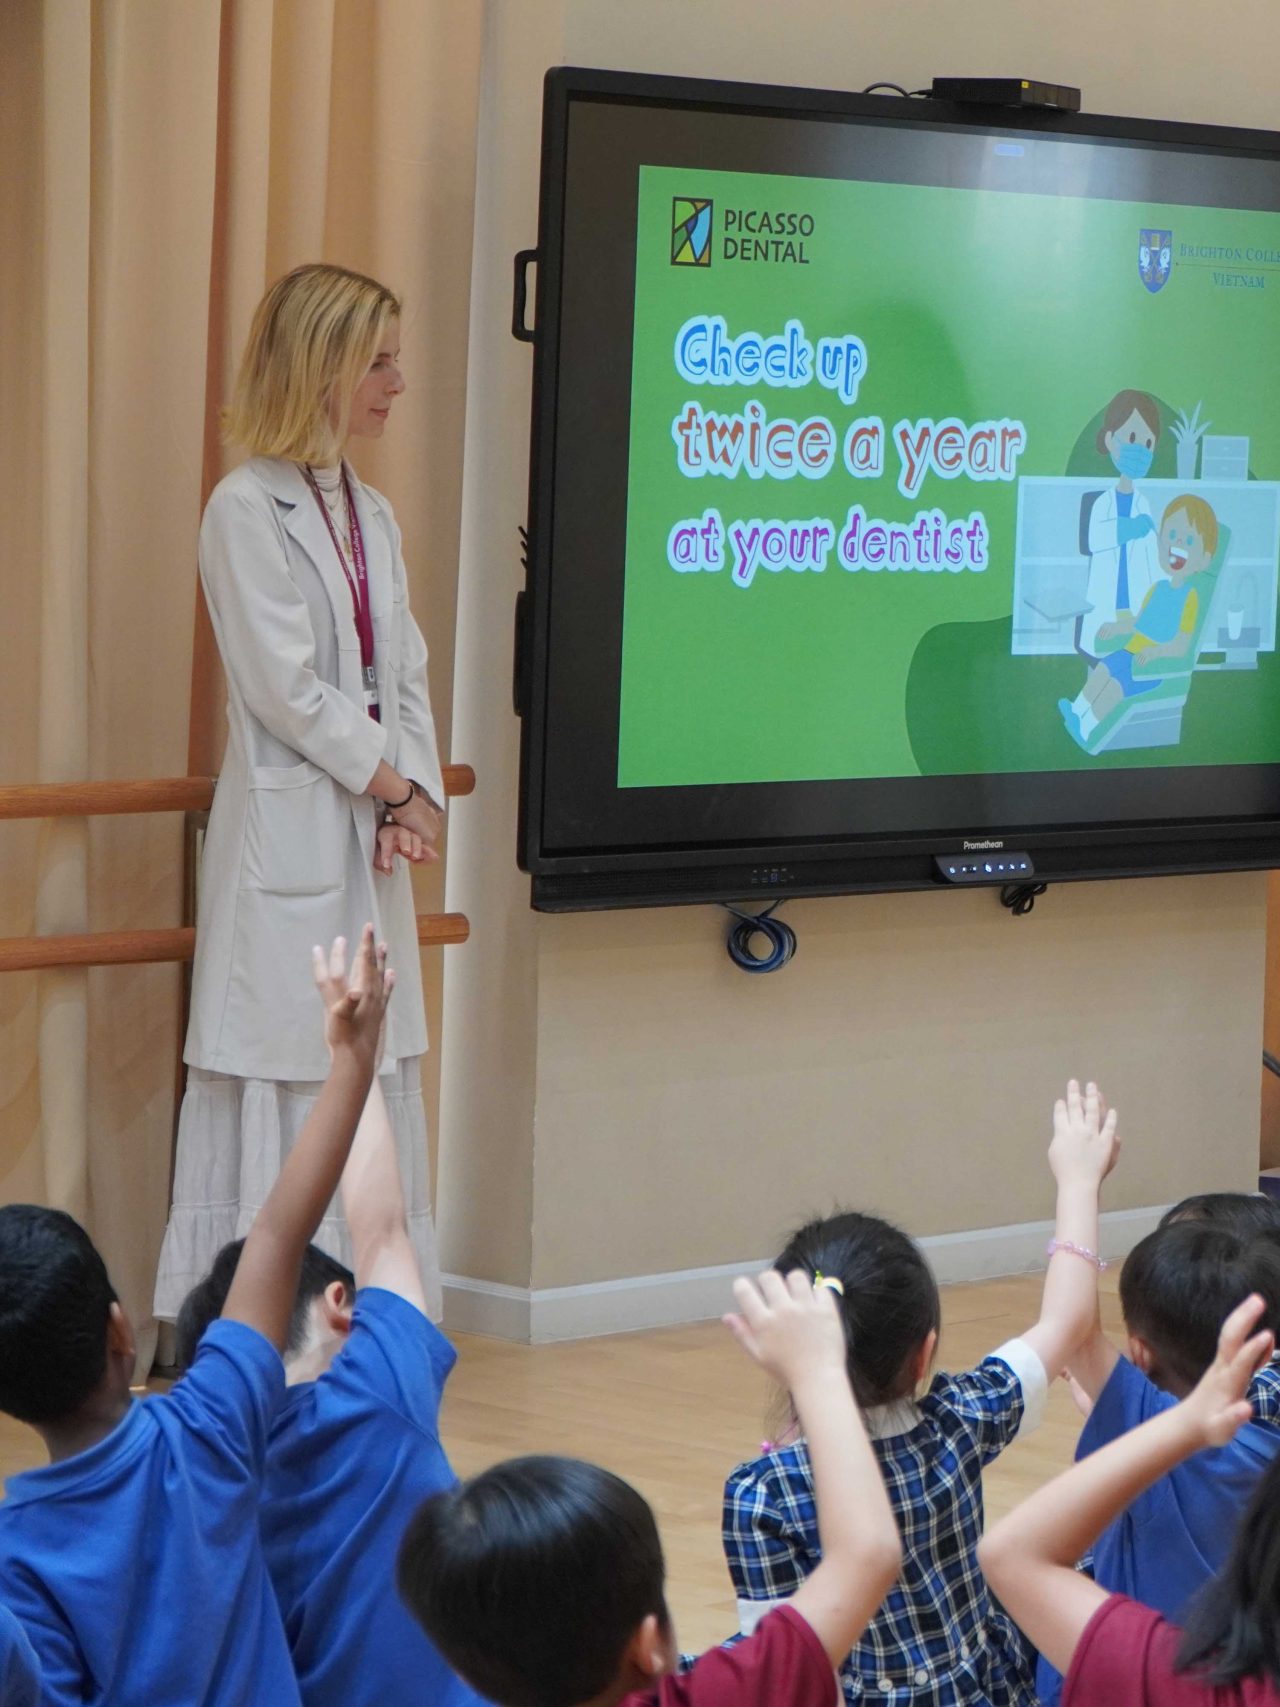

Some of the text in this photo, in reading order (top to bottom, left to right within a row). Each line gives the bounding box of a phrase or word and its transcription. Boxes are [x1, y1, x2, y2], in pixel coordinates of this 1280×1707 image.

[724, 209, 815, 237] PICASSO
[723, 237, 810, 264] DENTAL
[1179, 243, 1242, 261] BRIGHTON
[1213, 273, 1265, 289] VIETNAM
[679, 321, 864, 398] Check up
[676, 402, 1024, 491] twice a year
[670, 511, 986, 580] at your dentist
[963, 840, 1004, 850] Promethean
